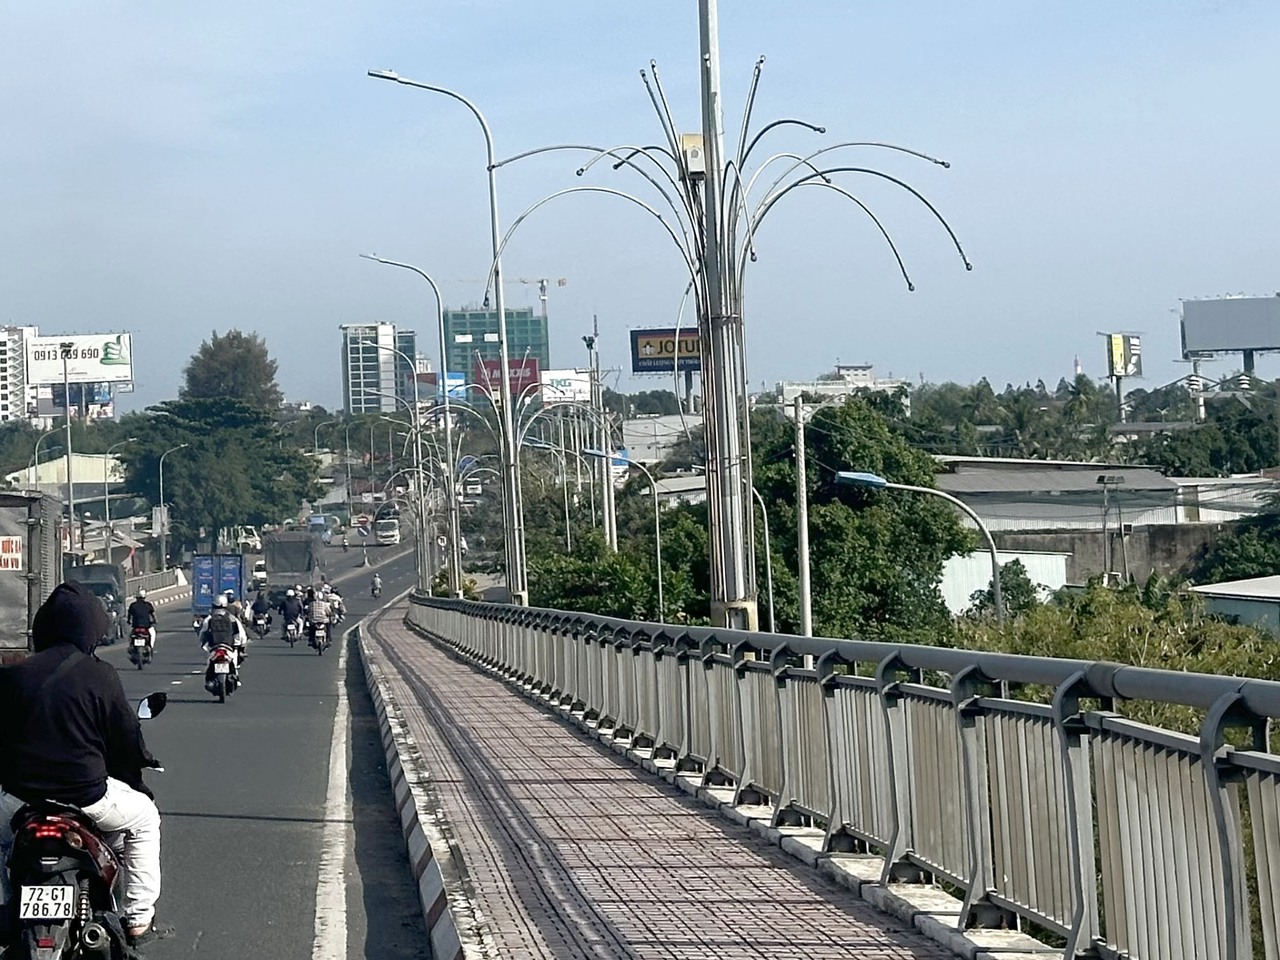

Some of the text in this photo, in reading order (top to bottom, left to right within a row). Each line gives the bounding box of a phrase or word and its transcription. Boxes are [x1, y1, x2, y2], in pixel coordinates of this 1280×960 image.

[34, 350, 58, 361] 0913
[81, 347, 99, 359] 690
[492, 367, 532, 379] MXXIS
[29, 887, 65, 901] 72-G1
[23, 903, 71, 917] 786.78
